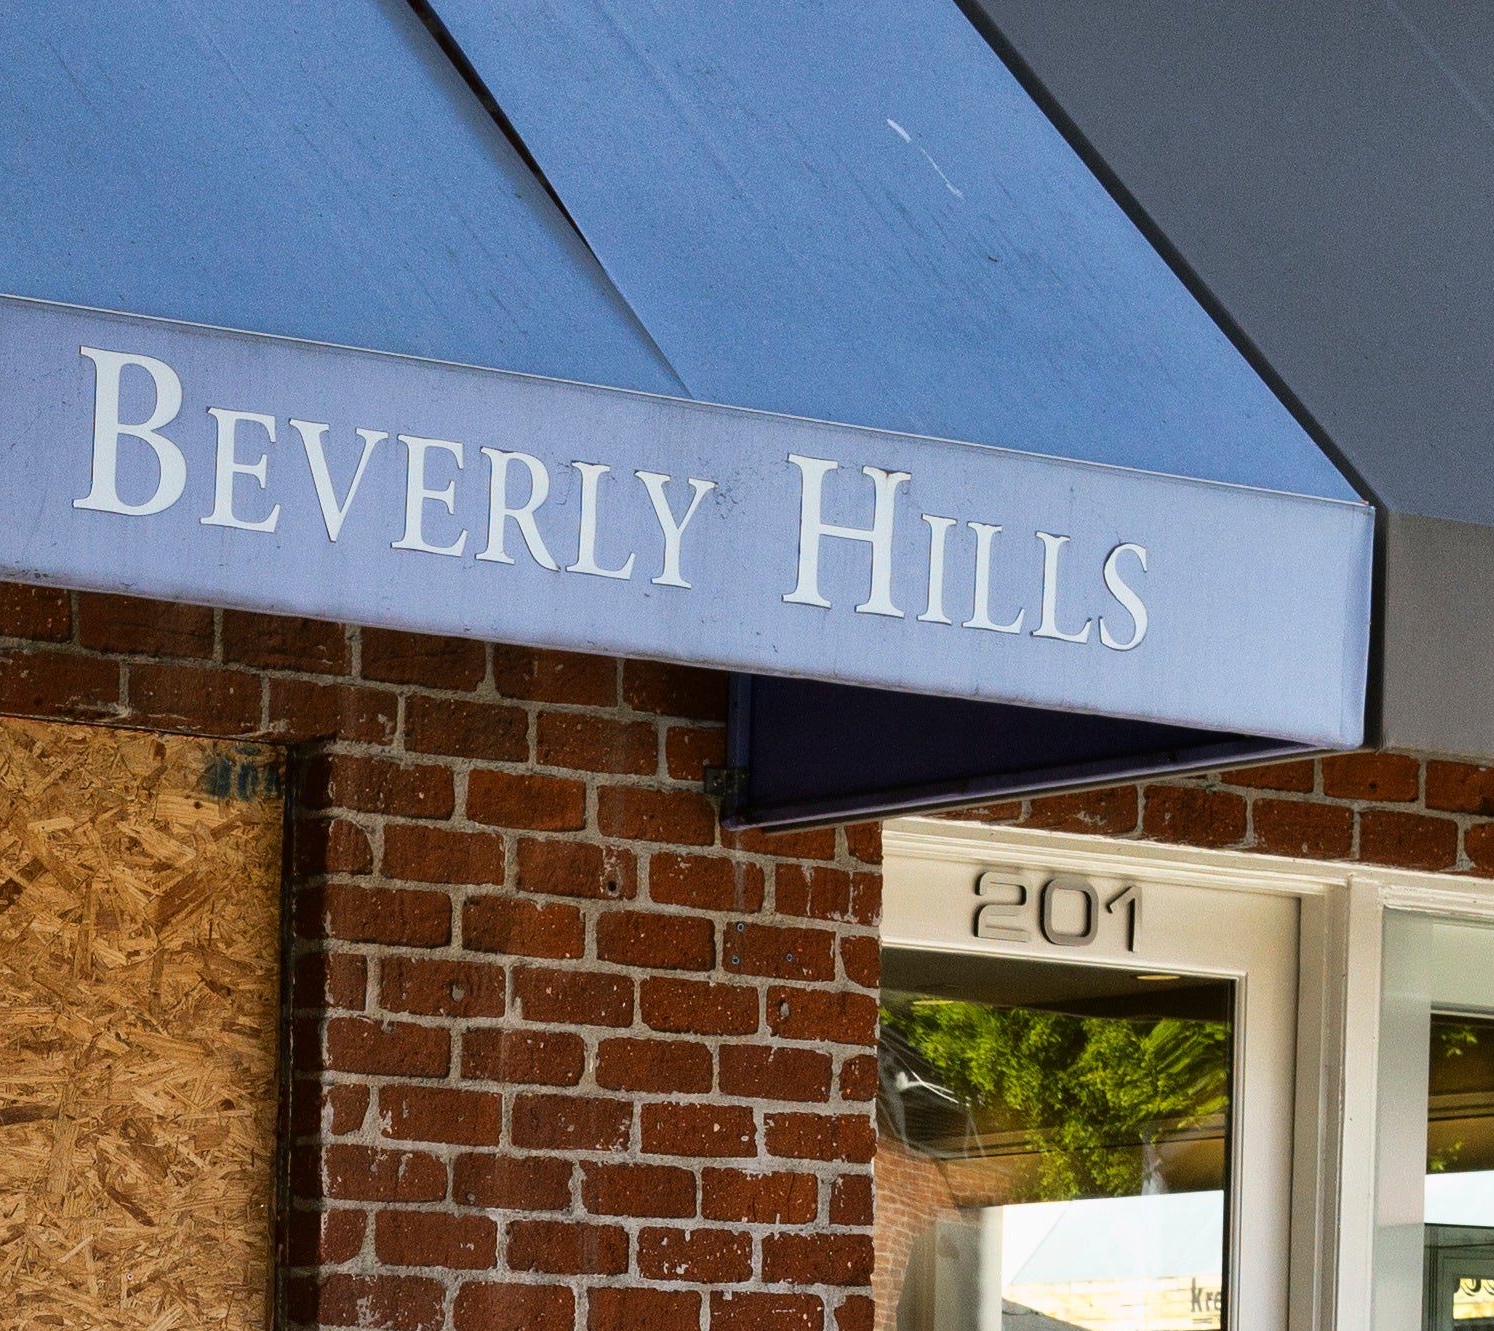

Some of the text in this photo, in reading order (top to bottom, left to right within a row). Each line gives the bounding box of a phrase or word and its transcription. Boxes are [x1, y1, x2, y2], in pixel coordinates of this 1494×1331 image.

[71, 344, 717, 591] BEVERLY
[781, 452, 1151, 652] HILLS
[974, 869, 1144, 953] 201
